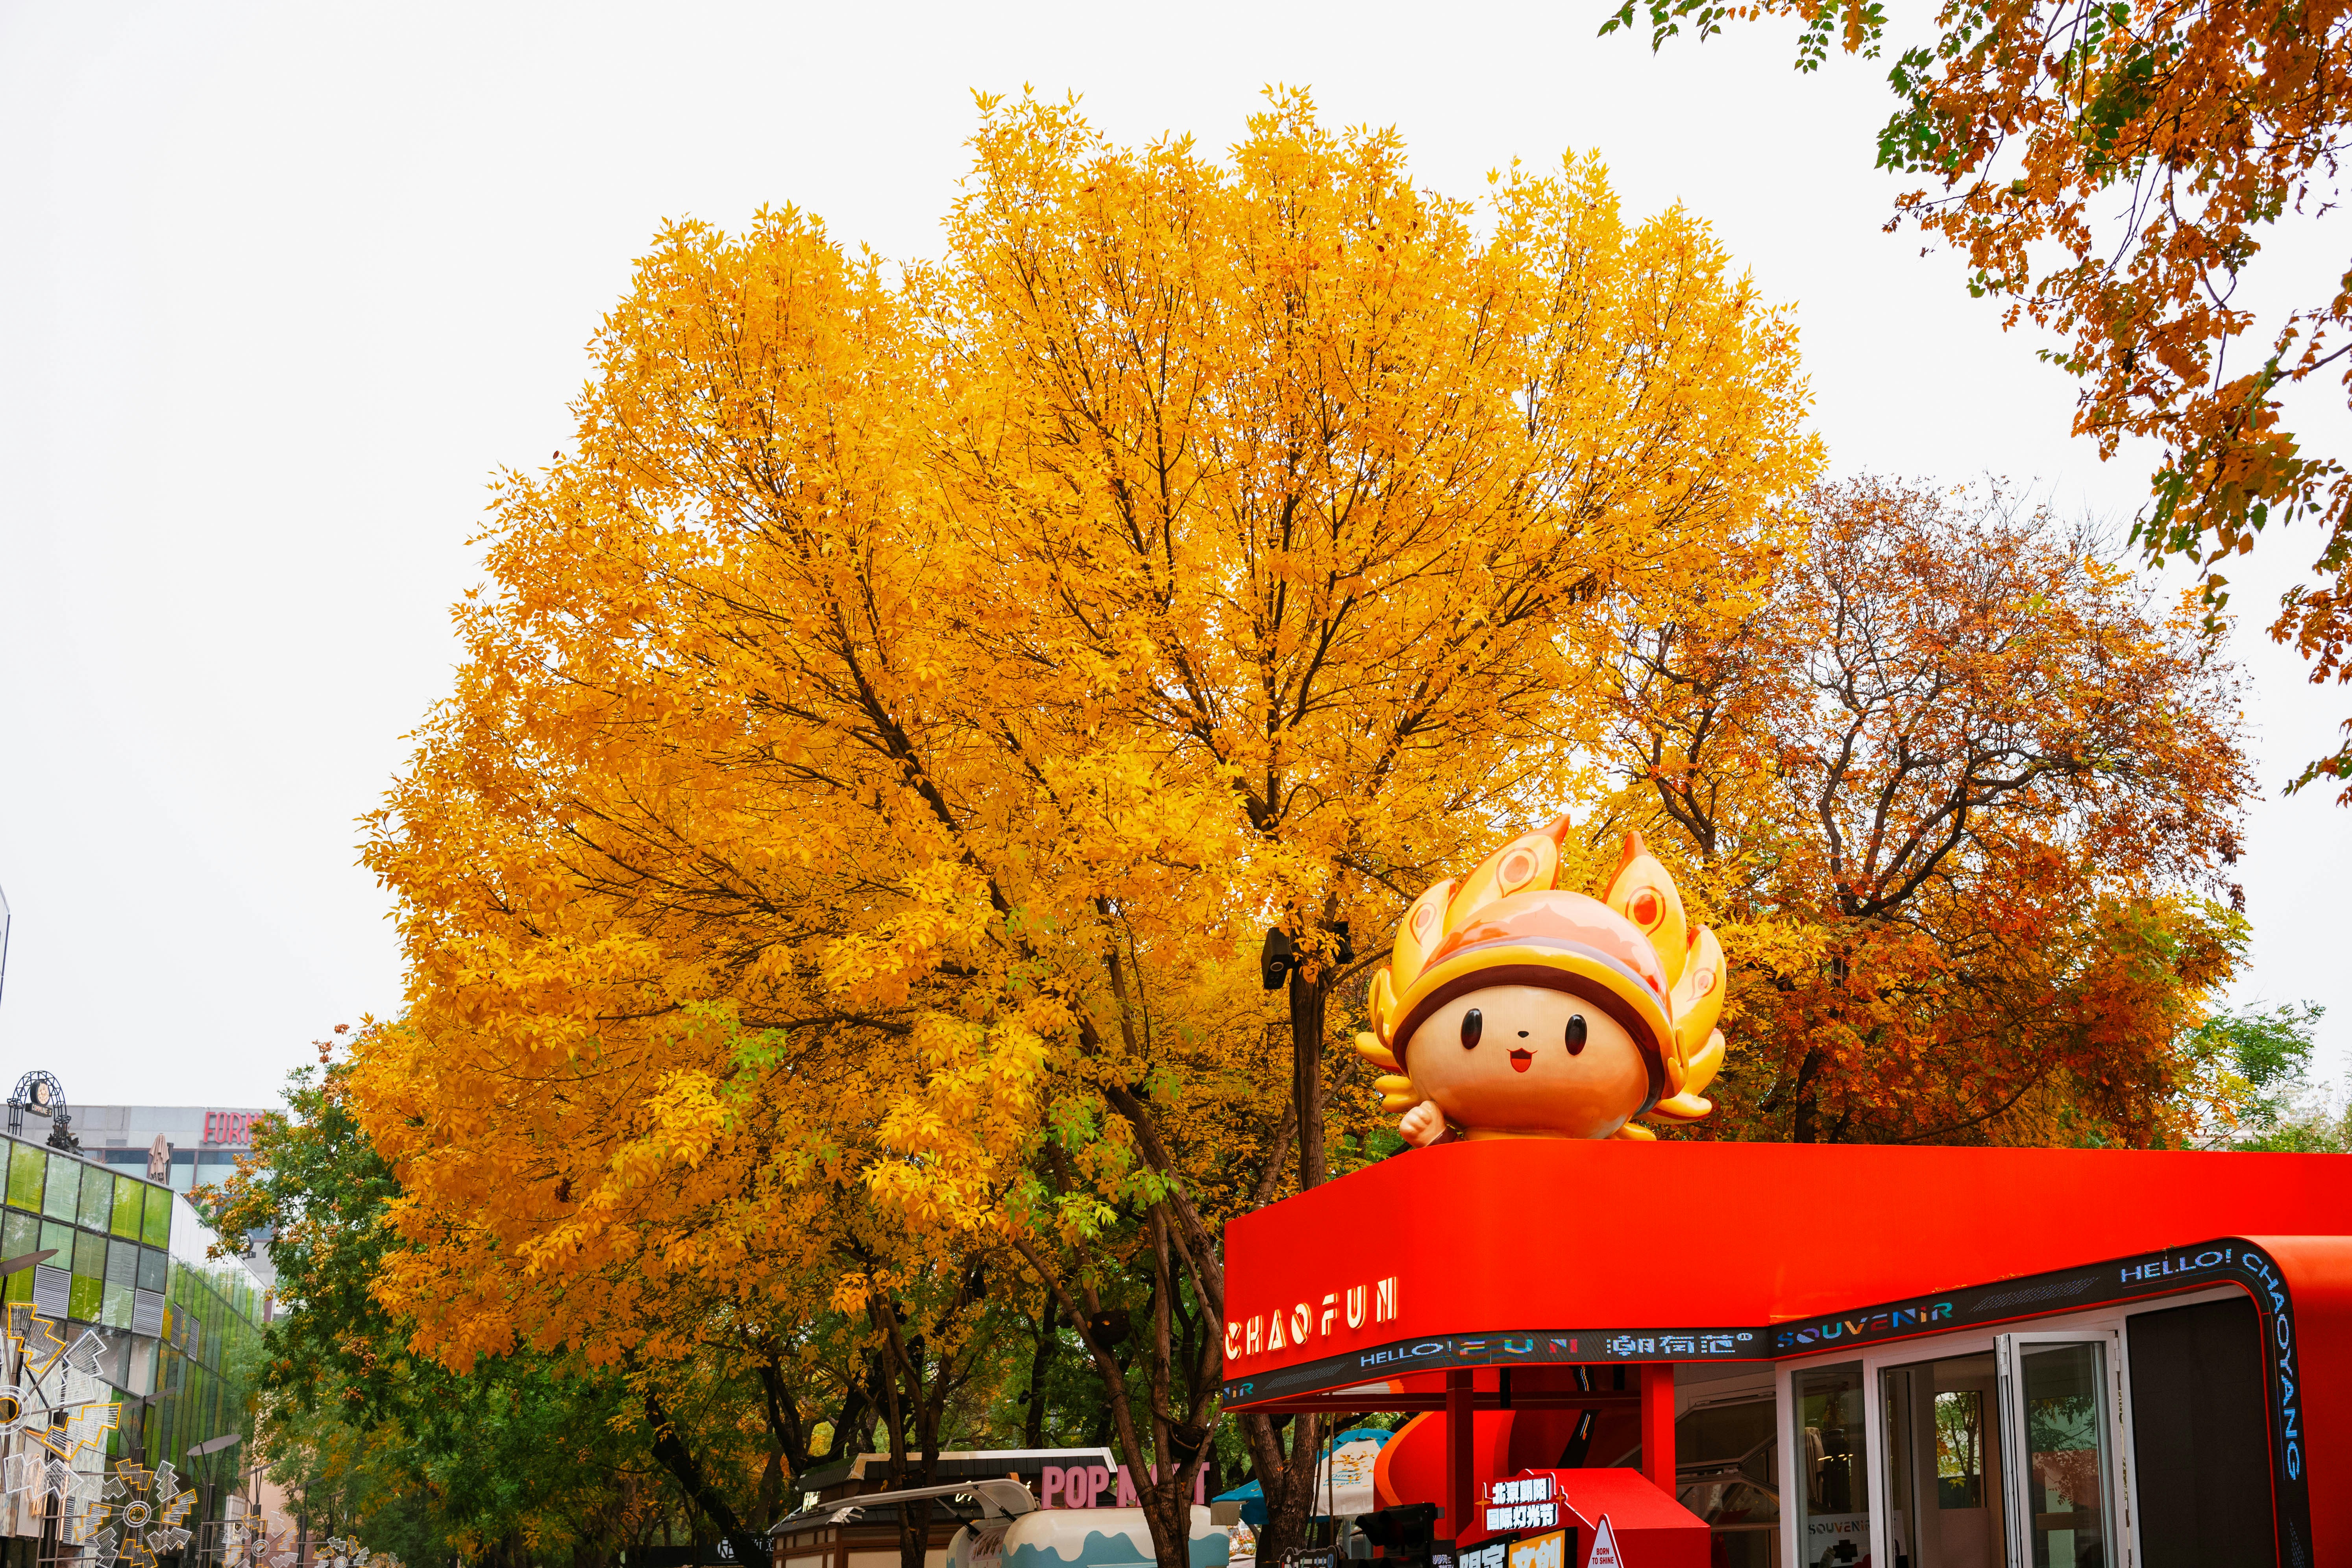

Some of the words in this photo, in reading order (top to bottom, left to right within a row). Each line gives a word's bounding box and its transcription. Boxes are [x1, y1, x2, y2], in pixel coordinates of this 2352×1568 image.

[32, 1104, 48, 1115] COMMUNE
[1361, 1341, 1452, 1367] HELLO!
[2121, 1248, 2232, 1282] HELLO!
[2241, 1252, 2300, 1480] CHAOYANG
[1041, 1465, 1109, 1510] POP
[1492, 1477, 1551, 1505] 北京朝阳
[1487, 1503, 1558, 1531] 国际灯光节
[1599, 1556, 1614, 1564] SHINE
